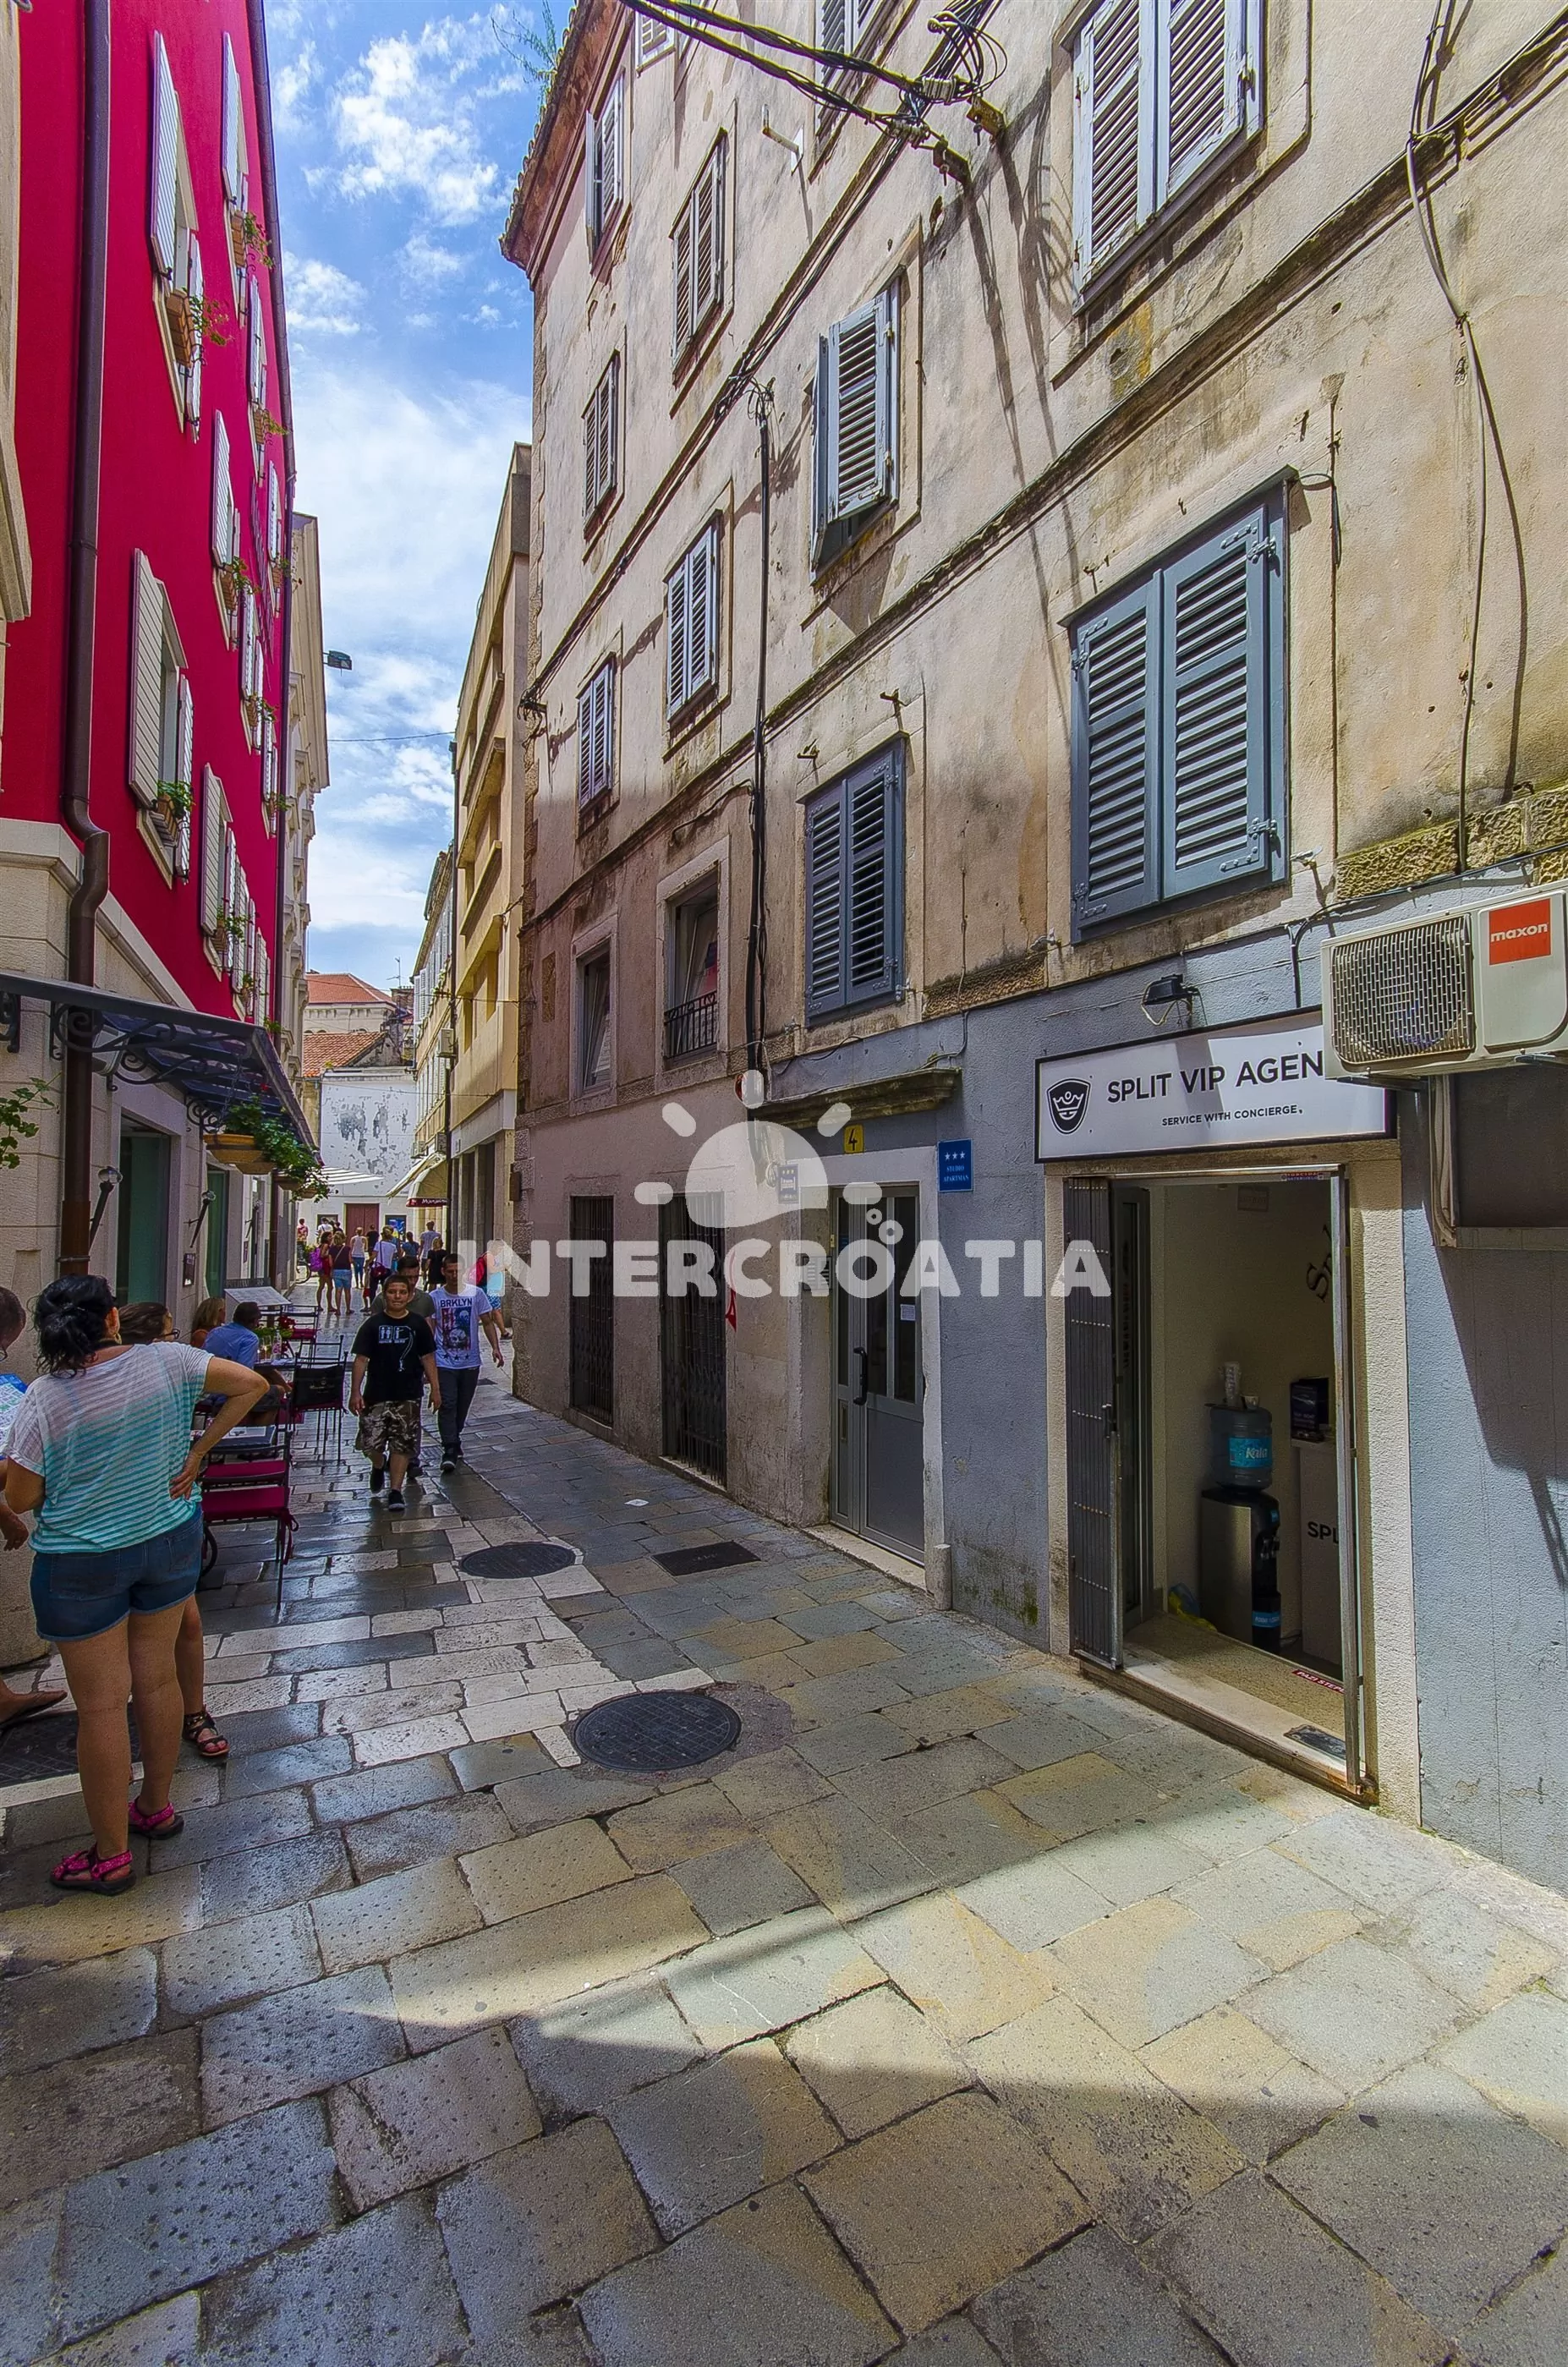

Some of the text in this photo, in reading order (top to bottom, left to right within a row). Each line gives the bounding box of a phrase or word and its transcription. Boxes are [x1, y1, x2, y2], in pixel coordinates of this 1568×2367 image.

[1490, 923, 1548, 942] maxon
[1107, 1050, 1324, 1103] SPLIT VIP AGEN
[1161, 1115, 1202, 1126] SERVICE
[1204, 1111, 1231, 1124] WITH
[848, 1128, 858, 1151] 4
[943, 1174, 969, 1182] APARTMAN
[440, 1298, 473, 1307] BRKLYN
[1297, 1671, 1318, 1681] PAZI
